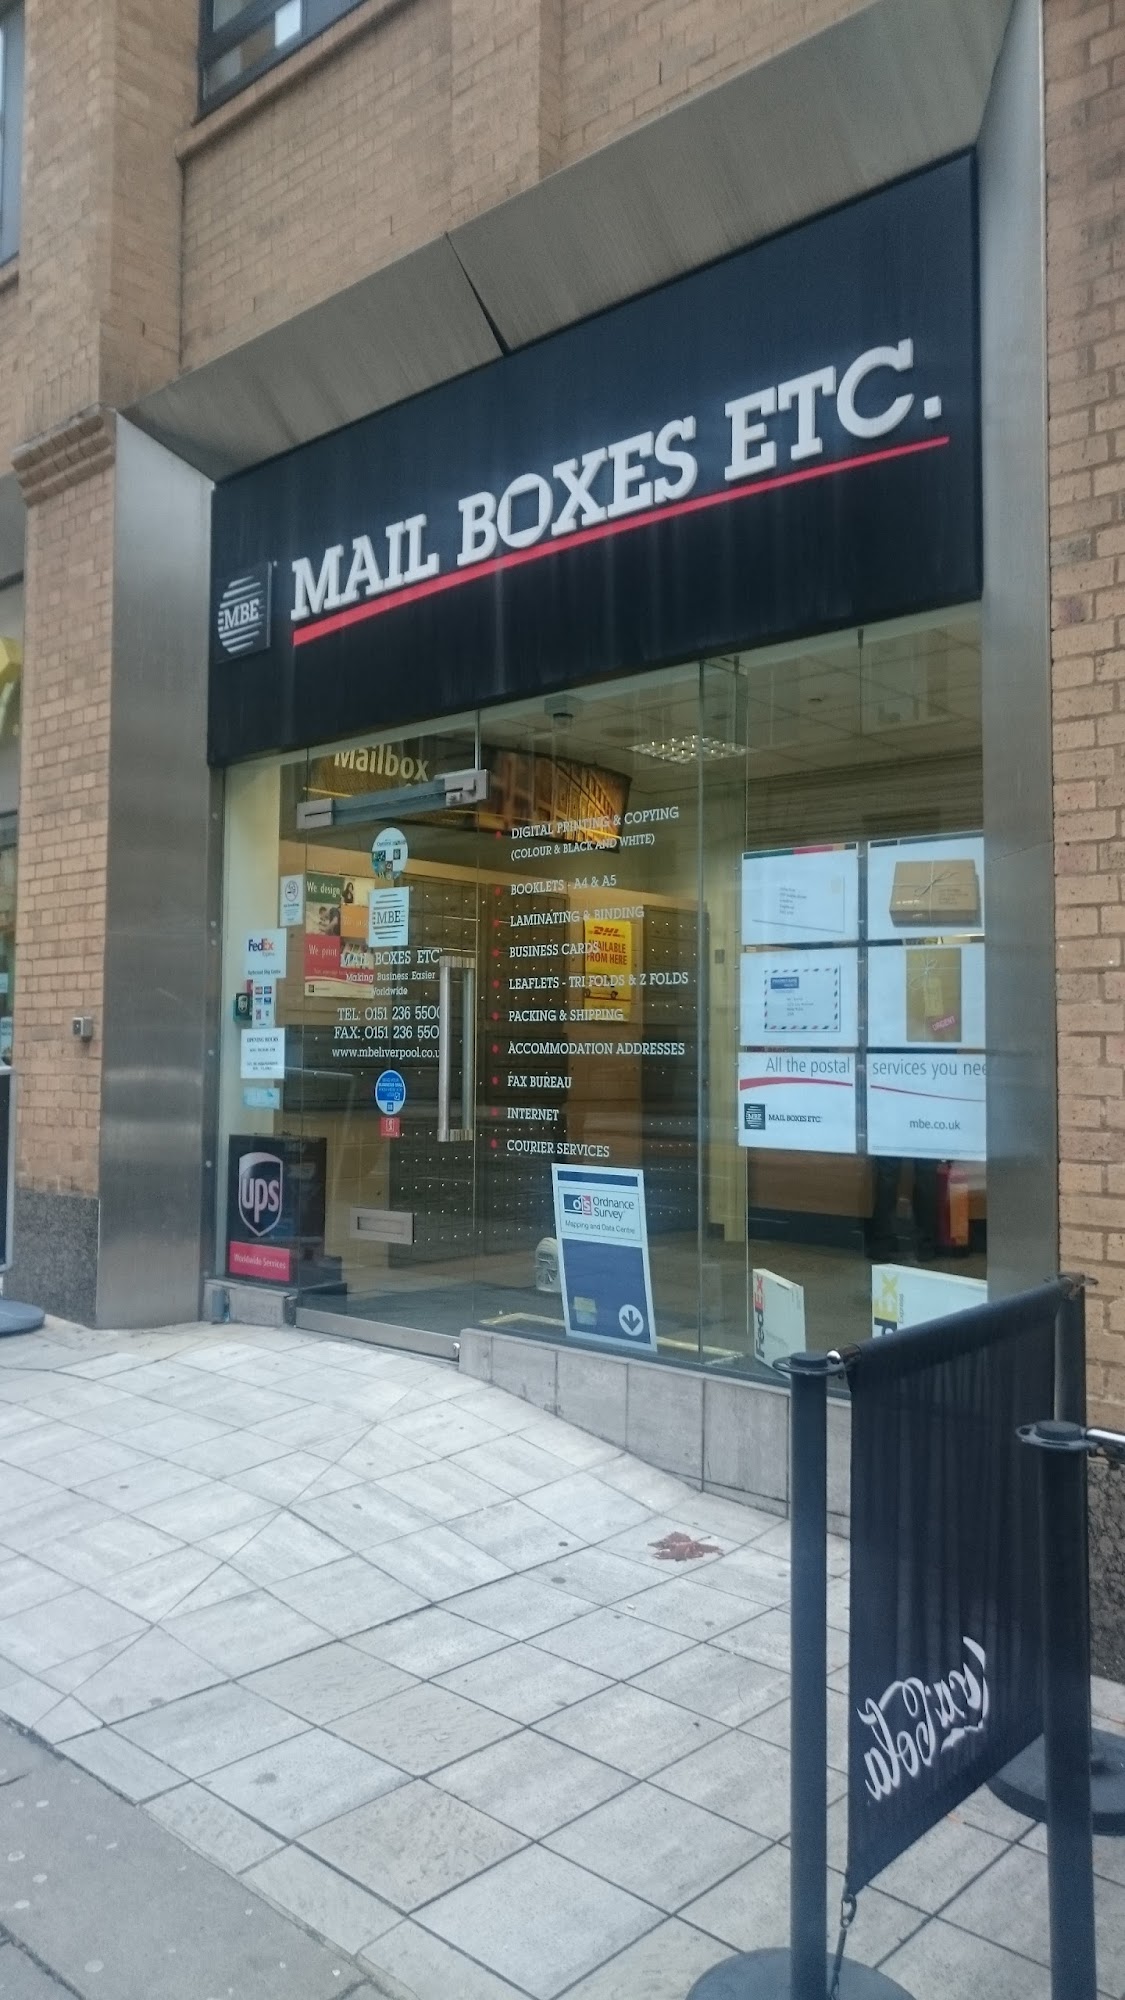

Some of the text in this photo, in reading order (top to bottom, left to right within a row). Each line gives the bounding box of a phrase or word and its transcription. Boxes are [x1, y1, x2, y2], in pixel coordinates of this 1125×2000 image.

[290, 337, 943, 621] MAIL BOXES ETC.
[223, 598, 260, 631] MBE
[334, 744, 430, 782] Mailbox
[511, 806, 679, 840] DIGITAL PRINTING & COPYING
[510, 833, 655, 861] (COLOUR & BLACK AND WHITE)
[306, 880, 341, 897] We design
[510, 879, 565, 895] BOOKLETS
[573, 877, 588, 889] A4
[591, 876, 599, 887] &
[601, 874, 617, 887] A5
[377, 911, 401, 924] MBE
[510, 905, 645, 927] LAMINATING & BINDING
[593, 926, 622, 937] DHL
[248, 938, 273, 952] FedEx
[308, 944, 337, 958] We print
[509, 941, 600, 958] BUSINESS CARDS
[375, 950, 411, 965] BOXES
[587, 952, 627, 965] FROM HERE
[346, 970, 436, 982] Making Business Easier
[508, 977, 559, 990] LEAFLETS
[569, 975, 586, 988] TRI
[588, 975, 625, 987] FOLDS
[628, 974, 637, 985] &
[639, 974, 647, 985] Z
[649, 972, 689, 985] FOLDS
[337, 1007, 361, 1021] TEL:
[364, 1006, 388, 1021] 0151
[392, 1005, 411, 1020] 236
[508, 1008, 624, 1022] PACKING & SHIPPING
[333, 1025, 440, 1039] FAX: 0151 236 550
[331, 1046, 440, 1060] www.mbeliverpool.co.u
[507, 1042, 685, 1055] ACCOMMODATION ADDRESSES
[765, 1057, 987, 1080] All the postal services you nee
[507, 1075, 572, 1089] FAX BUREAU
[507, 1107, 559, 1121] INTERNET
[909, 1119, 961, 1130] mbe.co.uk
[507, 1139, 610, 1157] COURIER SERVICES
[241, 1178, 280, 1223] ups
[592, 1196, 635, 1210] Ordnance
[594, 1207, 624, 1221] Survey
[565, 1220, 589, 1230] Mapping
[616, 1225, 636, 1234] Centre
[234, 1253, 286, 1269] Worldwide Services
[873, 1274, 898, 1334] dEx
[754, 1275, 765, 1358] FedEx
